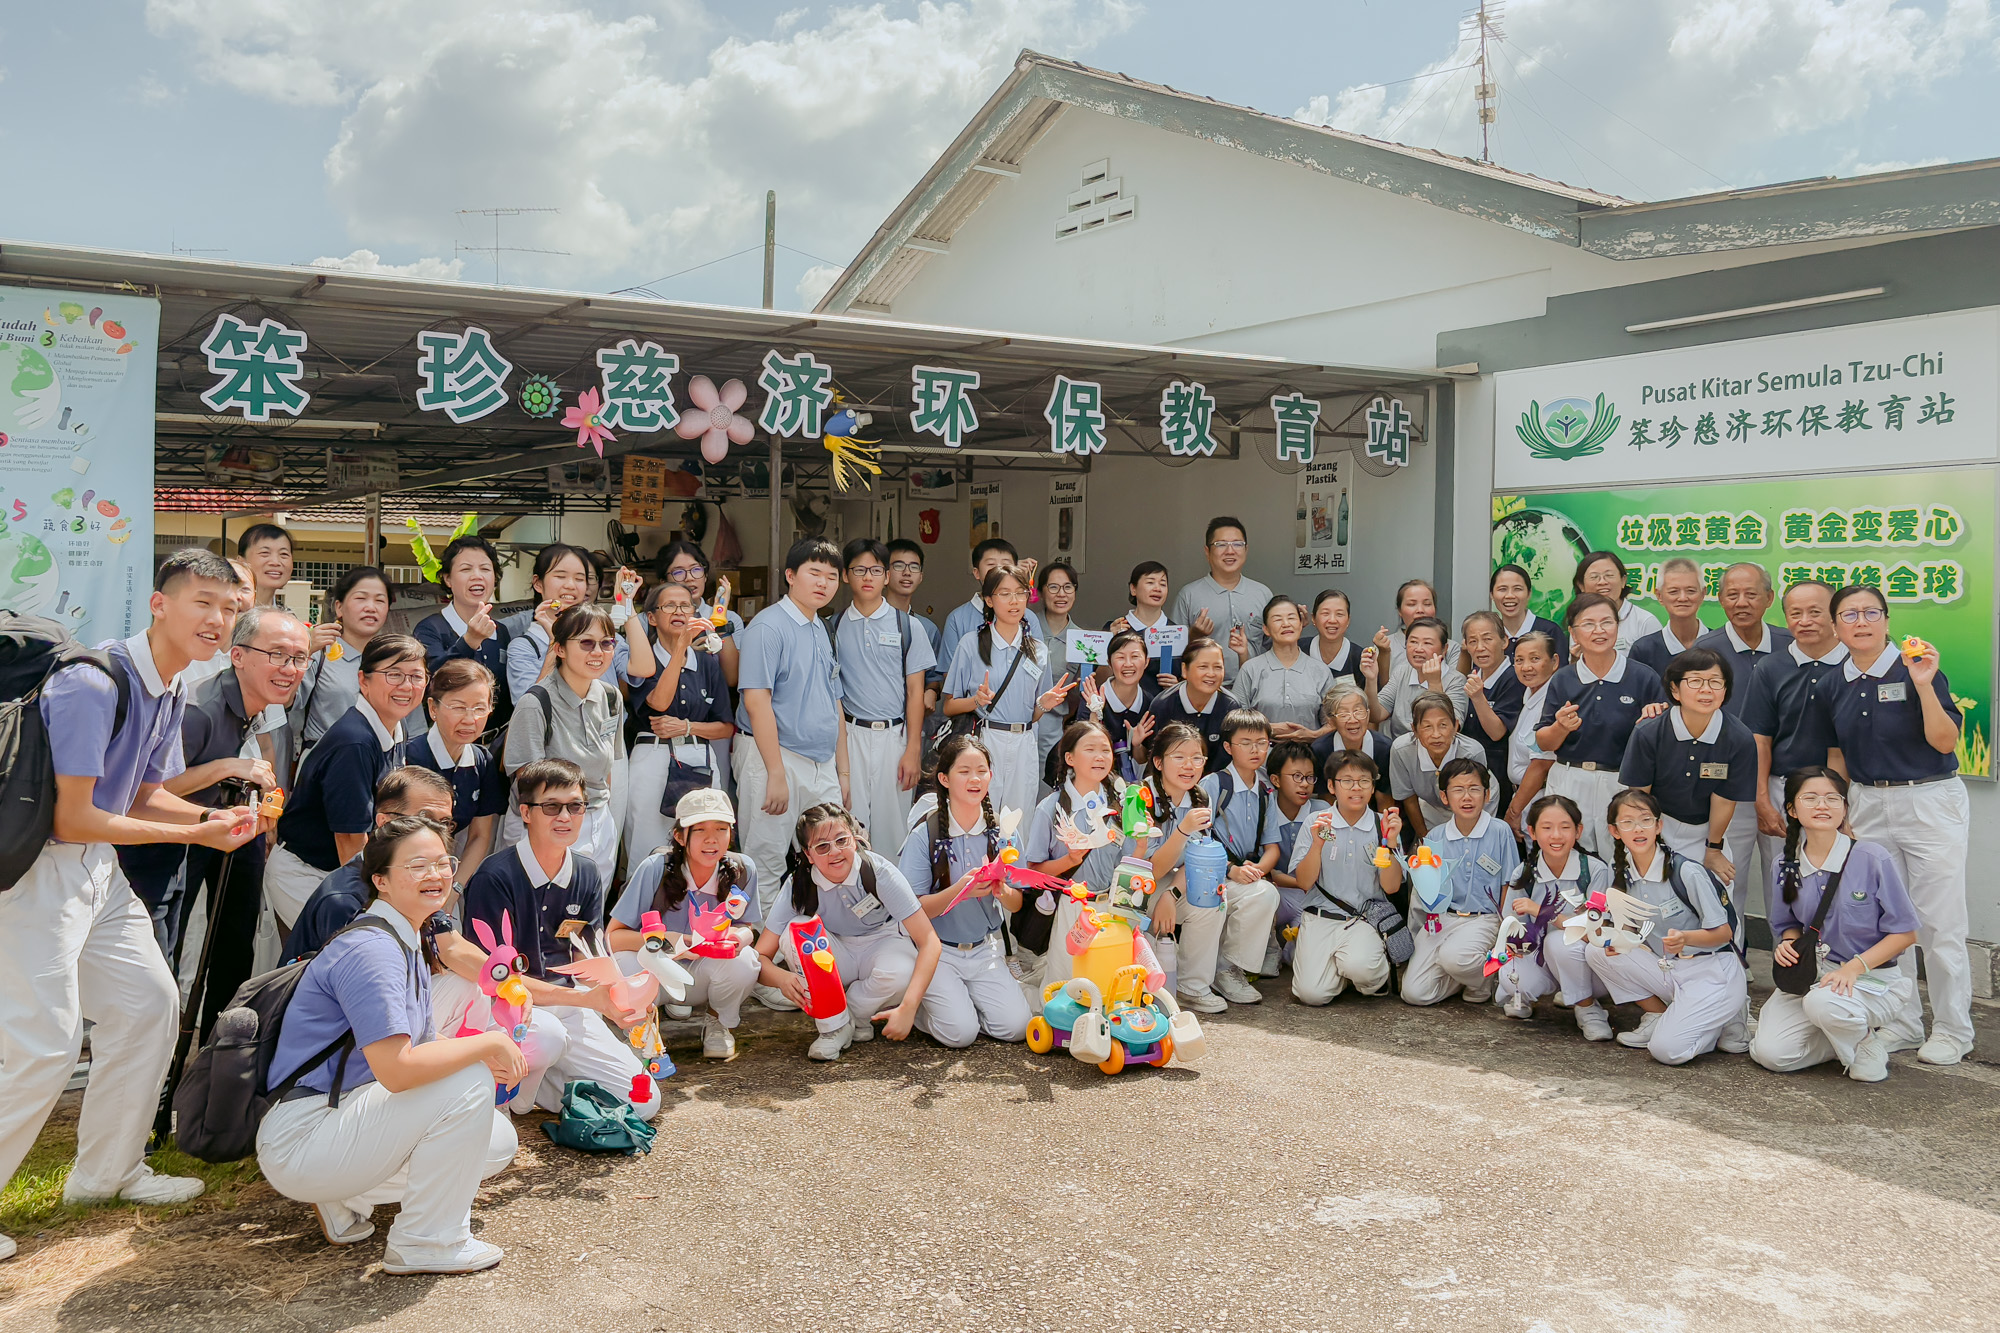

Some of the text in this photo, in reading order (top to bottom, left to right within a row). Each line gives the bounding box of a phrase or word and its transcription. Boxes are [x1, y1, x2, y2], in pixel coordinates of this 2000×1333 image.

[0, 319, 37, 331] udah
[6, 332, 35, 343] Bumi
[43, 329, 103, 347] 3 Kebaikan
[1641, 351, 1943, 405] Pusat Kitar Semula Tzu-Chi
[200, 313, 1412, 467] 笨珍慈济环保教育站
[1627, 391, 1956, 452] 笨珍慈济环保教育站
[1305, 461, 1338, 473] Barang
[1055, 480, 1077, 492] Barang
[1305, 473, 1338, 485] Plastik
[1049, 493, 1083, 505] Aluminium
[1619, 507, 1959, 548] 垃圾变黄金 黄金变爱心
[1297, 552, 1345, 569] 塑料品
